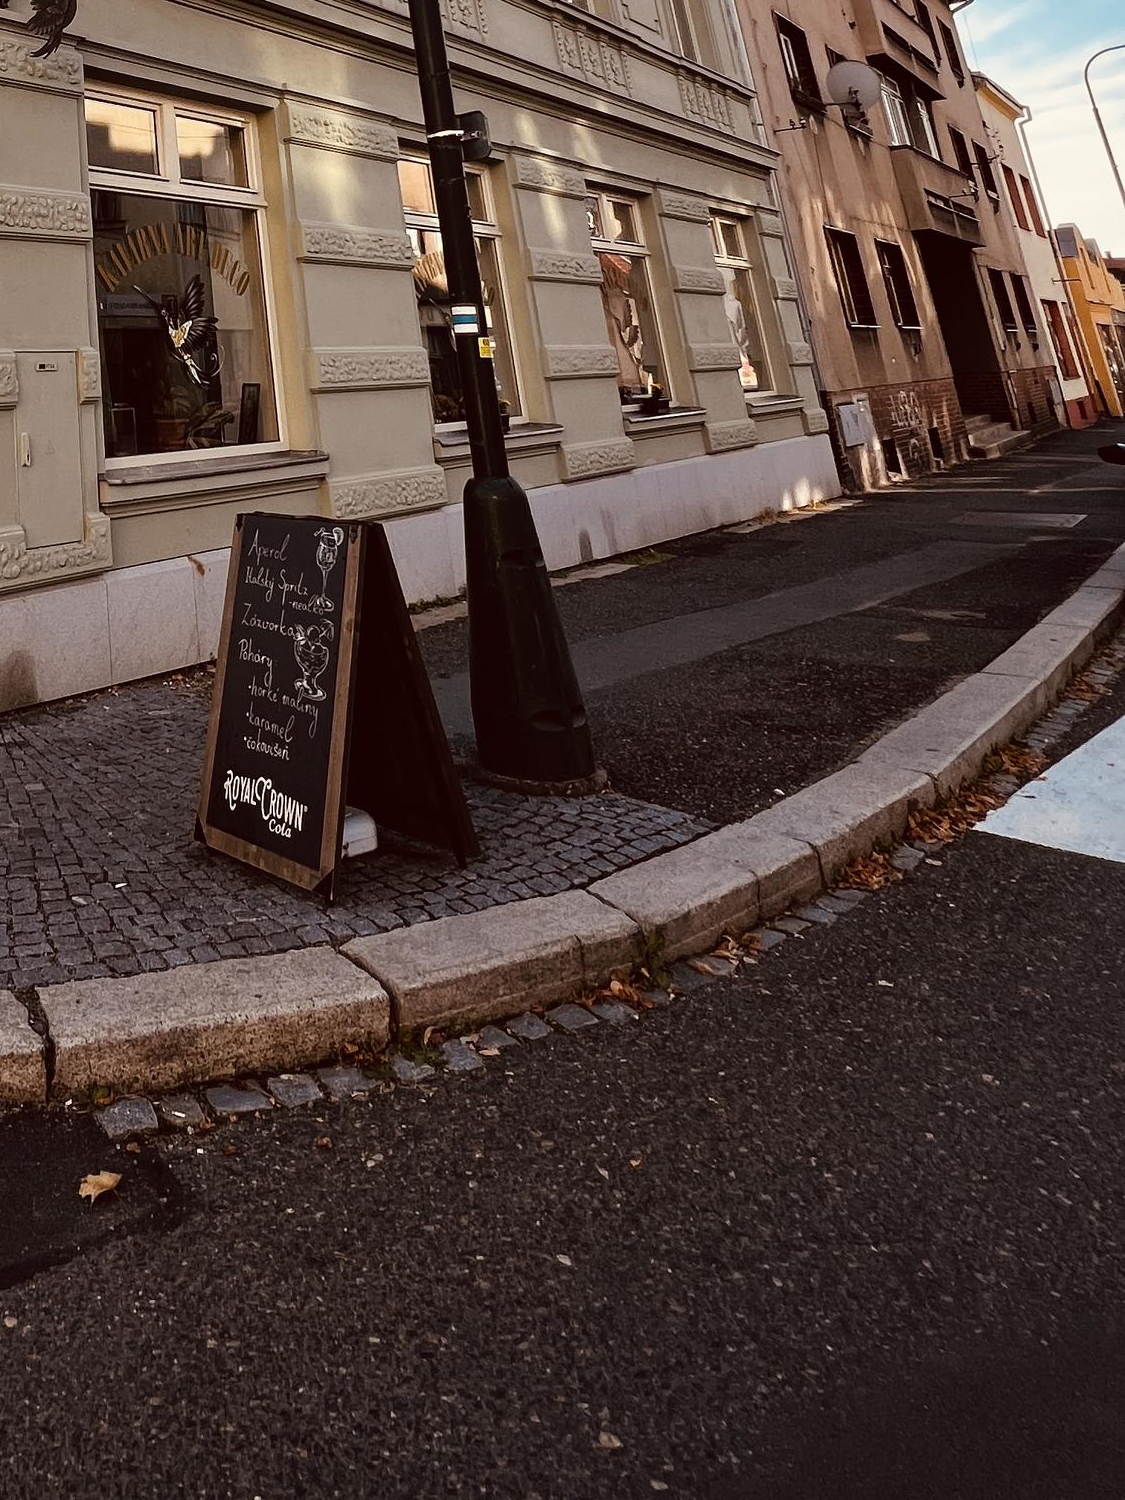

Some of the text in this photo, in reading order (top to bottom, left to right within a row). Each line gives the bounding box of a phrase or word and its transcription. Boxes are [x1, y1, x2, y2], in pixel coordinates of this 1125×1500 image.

[211, 242, 250, 296] DECO
[247, 528, 291, 566] Aperol
[278, 569, 309, 606] Spritz
[248, 701, 295, 743] karamel
[251, 675, 319, 739] horké maliny
[224, 769, 304, 831] ROYAL CROWN
[268, 818, 292, 838] Cola
